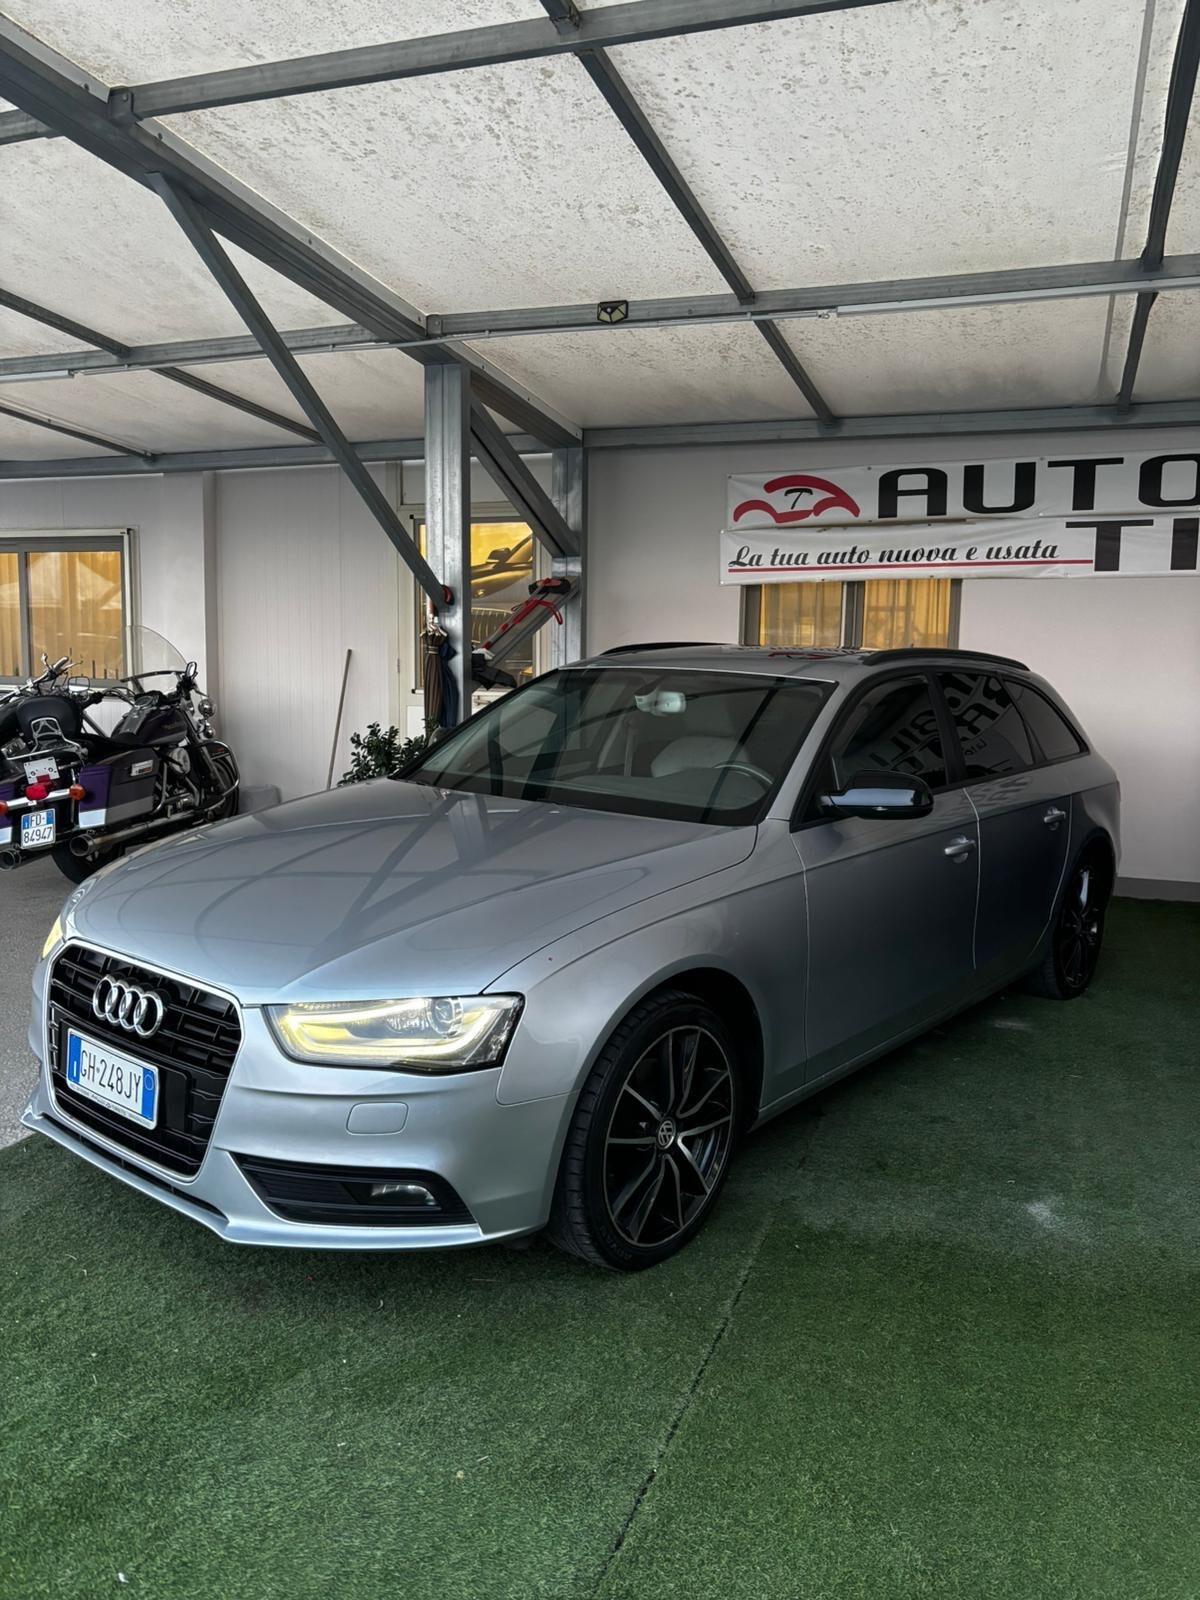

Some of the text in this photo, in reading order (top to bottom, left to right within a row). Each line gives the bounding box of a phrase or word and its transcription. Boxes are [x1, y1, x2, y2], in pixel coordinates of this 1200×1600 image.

[878, 453, 1200, 519] AUTO
[728, 539, 1059, 567] La tua auto nuova e usata
[23, 826, 53, 844] 84947
